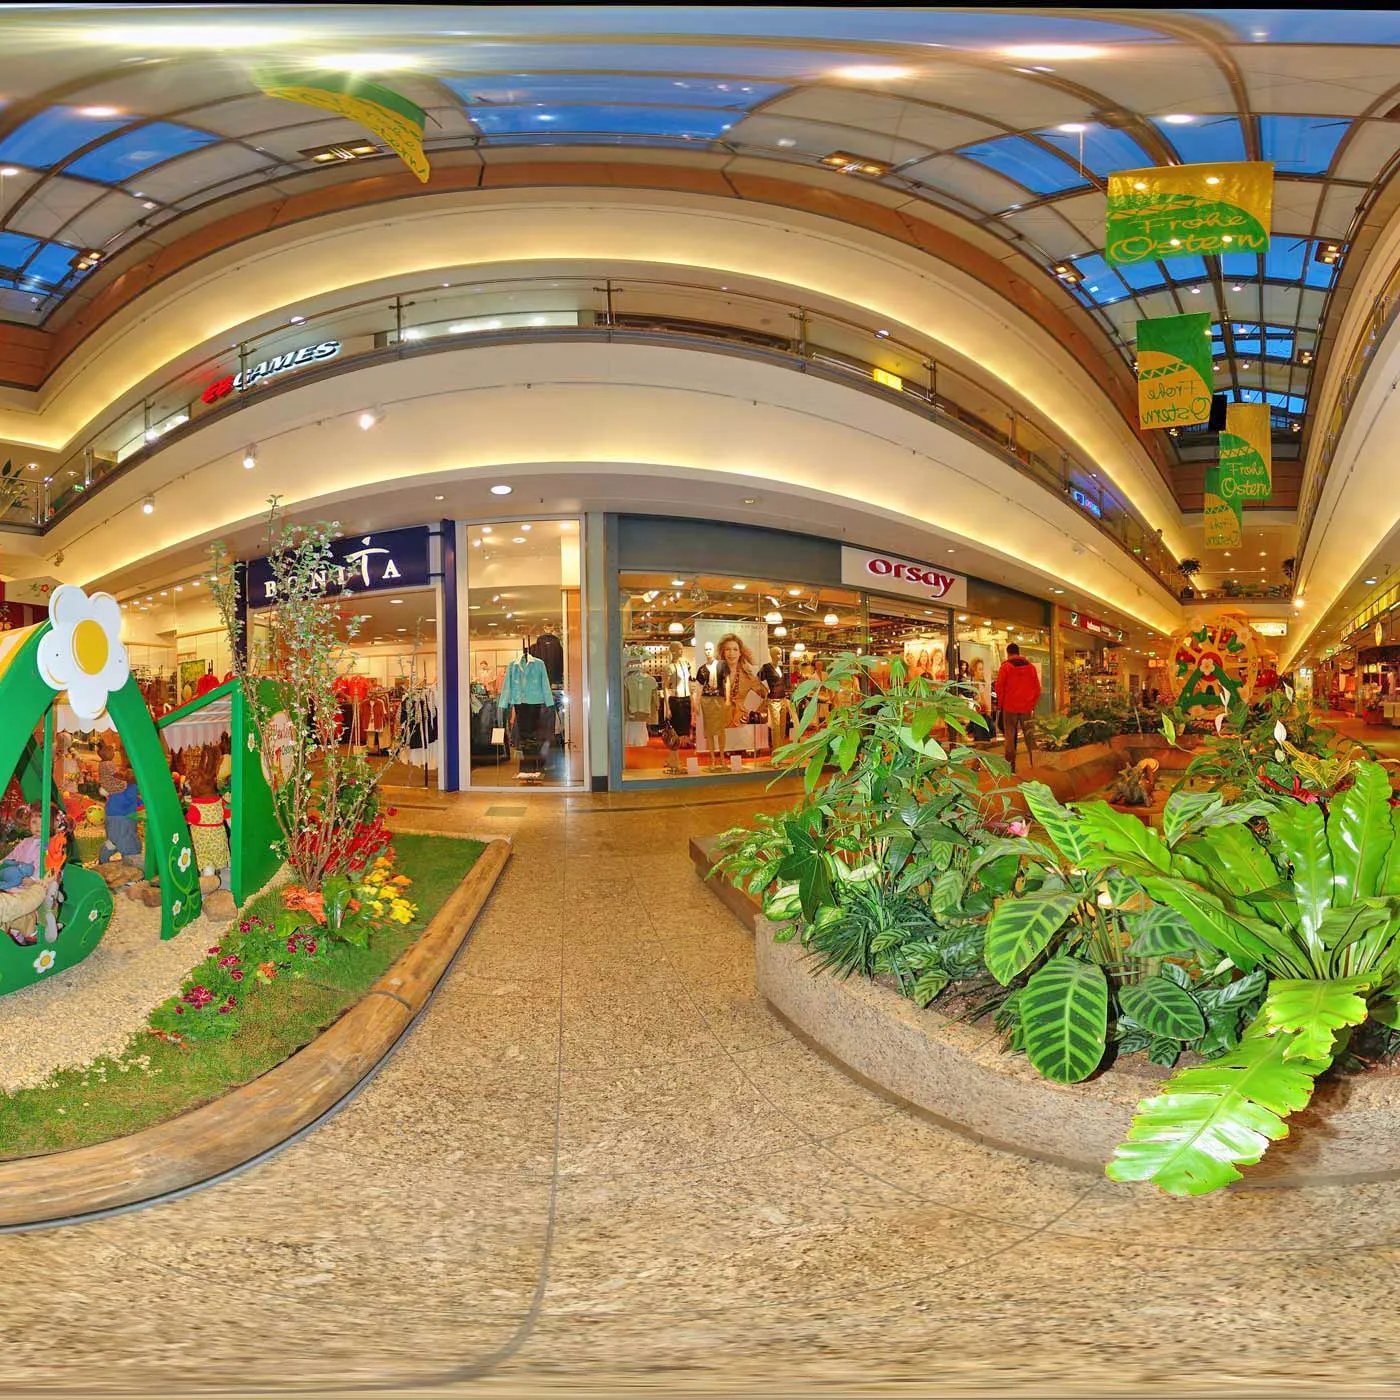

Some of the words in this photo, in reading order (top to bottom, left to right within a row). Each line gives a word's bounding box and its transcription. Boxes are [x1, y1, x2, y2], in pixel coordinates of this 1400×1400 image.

[1128, 212, 1247, 234] Frohe
[1110, 234, 1264, 263] Ostern
[1226, 462, 1264, 476] Frohe
[1221, 477, 1271, 498] Ostern
[868, 559, 956, 598] orsay
